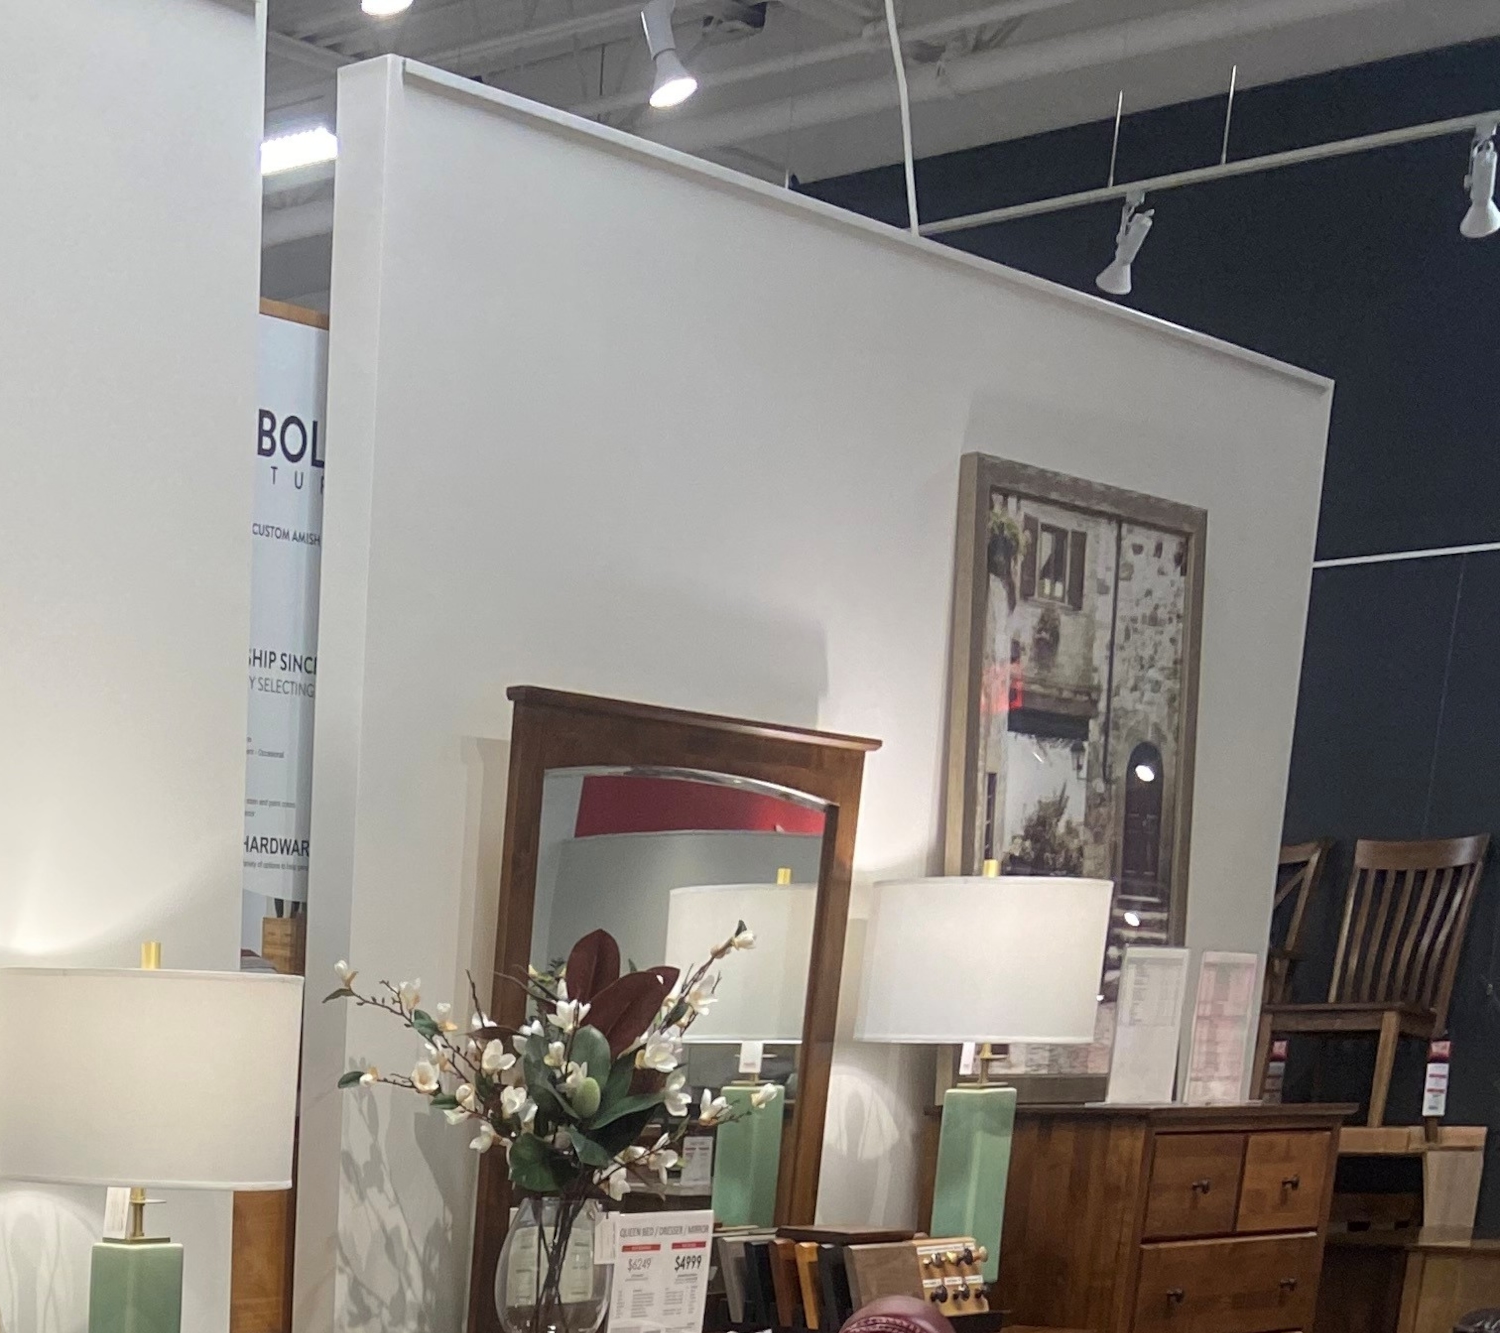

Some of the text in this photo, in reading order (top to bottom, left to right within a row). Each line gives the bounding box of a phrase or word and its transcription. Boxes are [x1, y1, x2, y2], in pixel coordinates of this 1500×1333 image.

[257, 408, 325, 469] BOL
[252, 522, 322, 547] CUSTOM AMISH
[257, 676, 315, 698] SELECTING
[620, 1227, 641, 1239] QUEEN
[642, 1226, 655, 1237] BED
[659, 1225, 683, 1236] DRESSER
[674, 1254, 703, 1272] $4999
